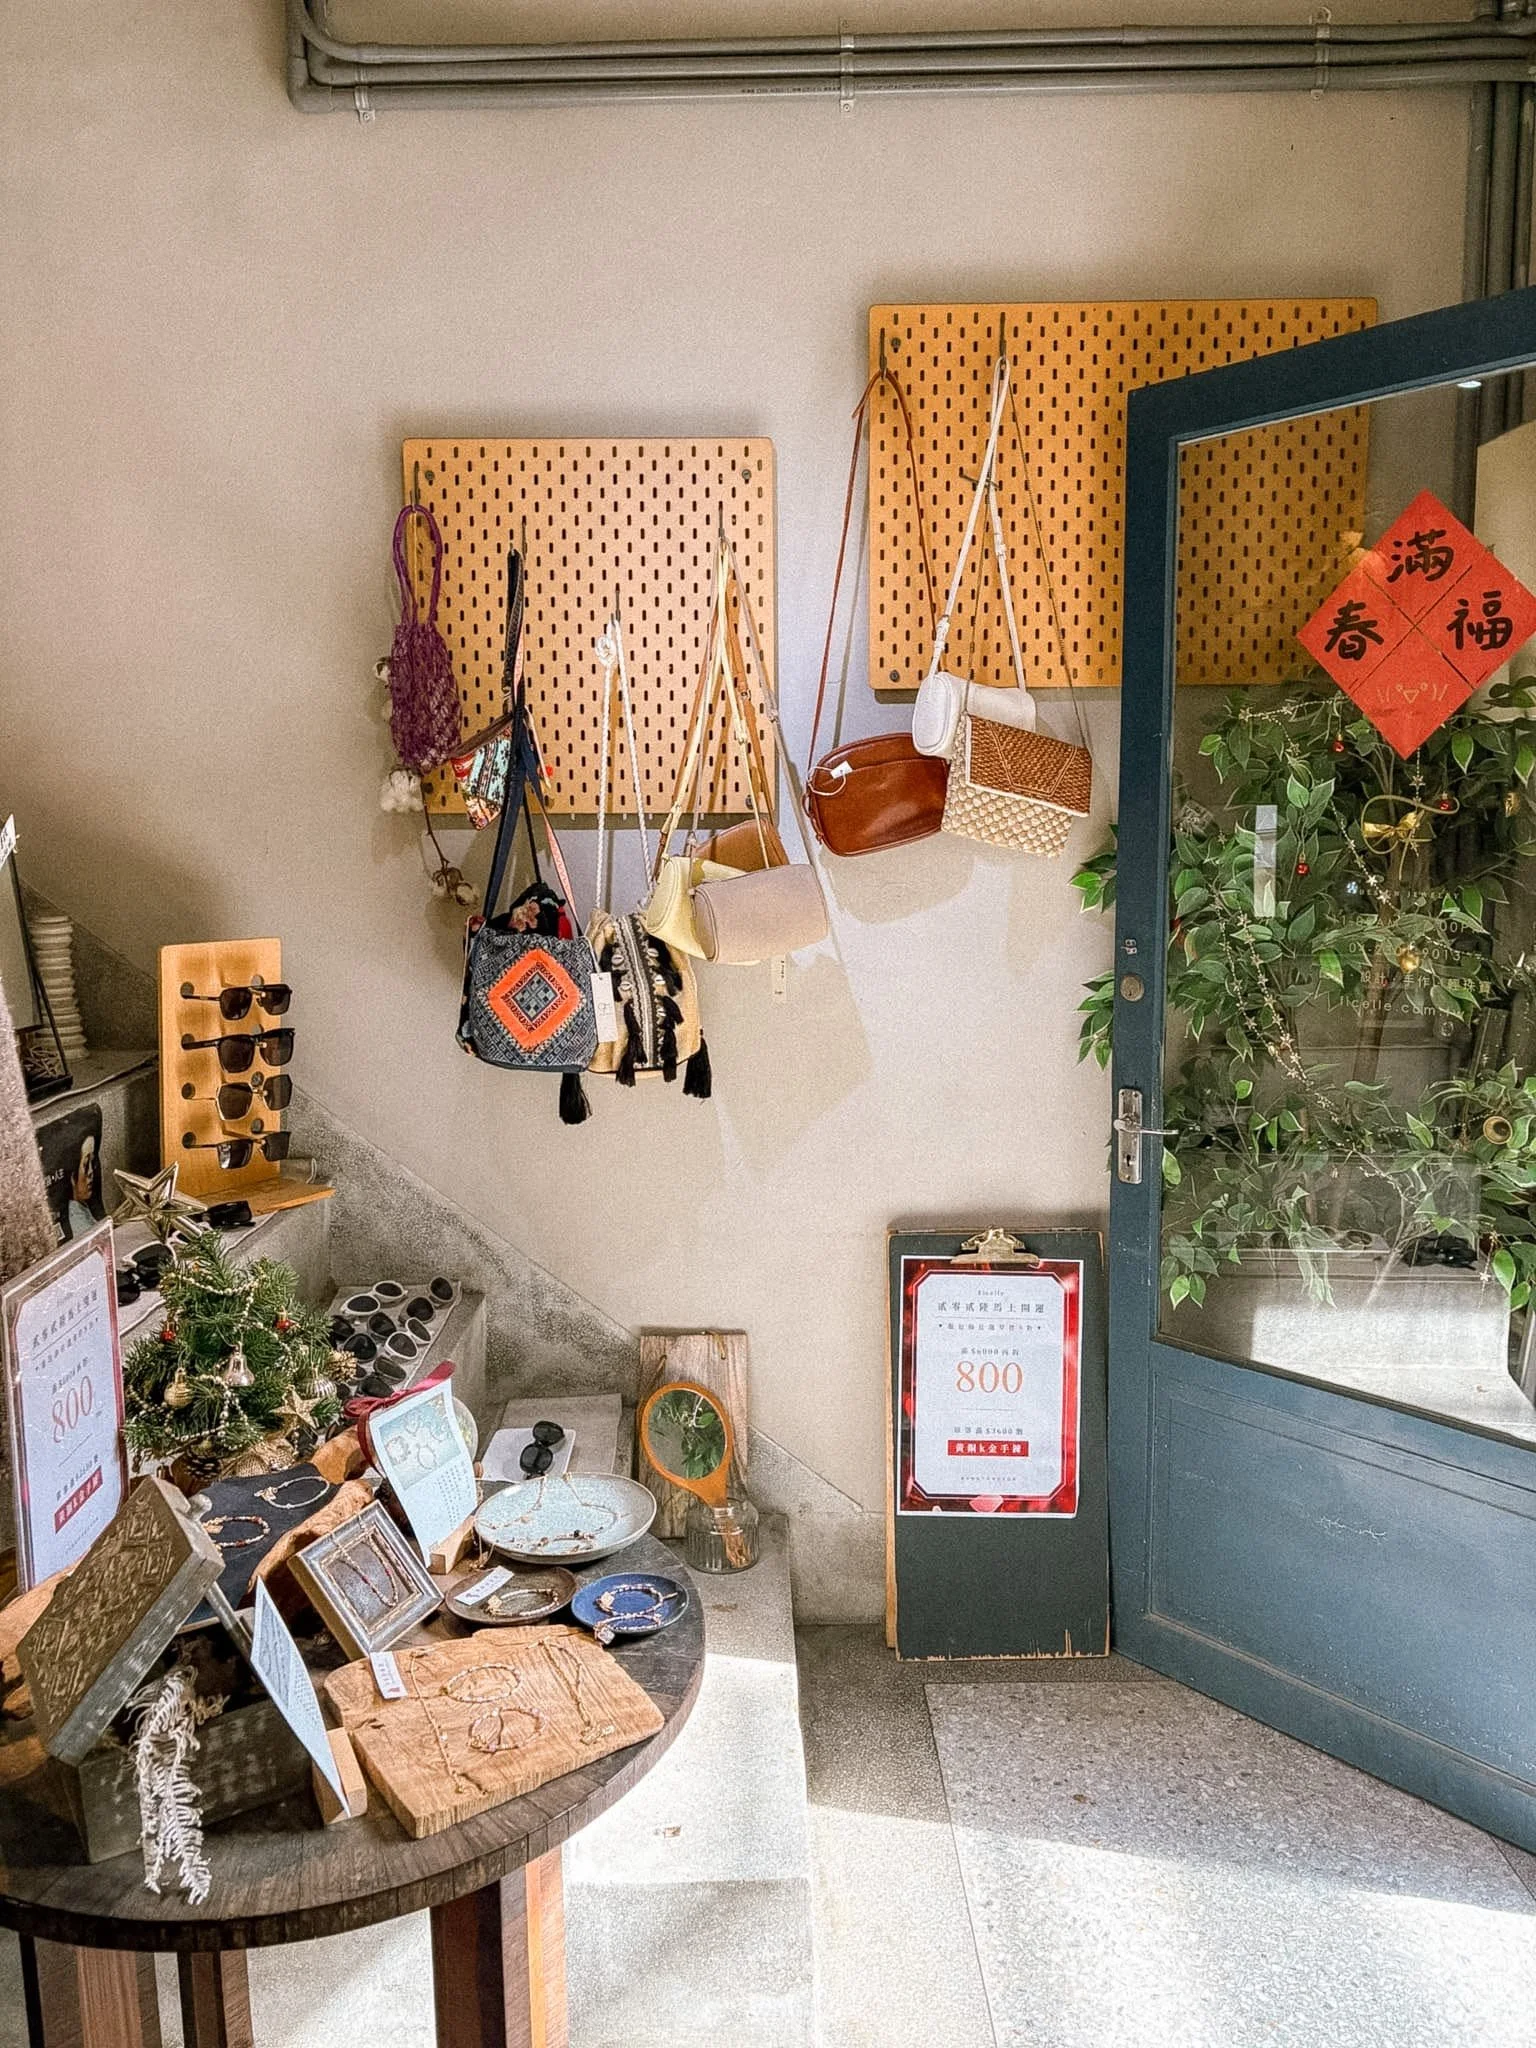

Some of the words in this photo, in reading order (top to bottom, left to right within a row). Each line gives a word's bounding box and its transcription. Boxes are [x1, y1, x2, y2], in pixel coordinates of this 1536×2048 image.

[1386, 528, 1455, 583] 滿
[1324, 600, 1385, 661] 春
[1446, 590, 1513, 651] 福
[1360, 888, 1400, 898] DESN
[1406, 886, 1459, 899] JEWELY
[955, 1360, 1023, 1394] 800
[52, 1375, 93, 1444] 800
